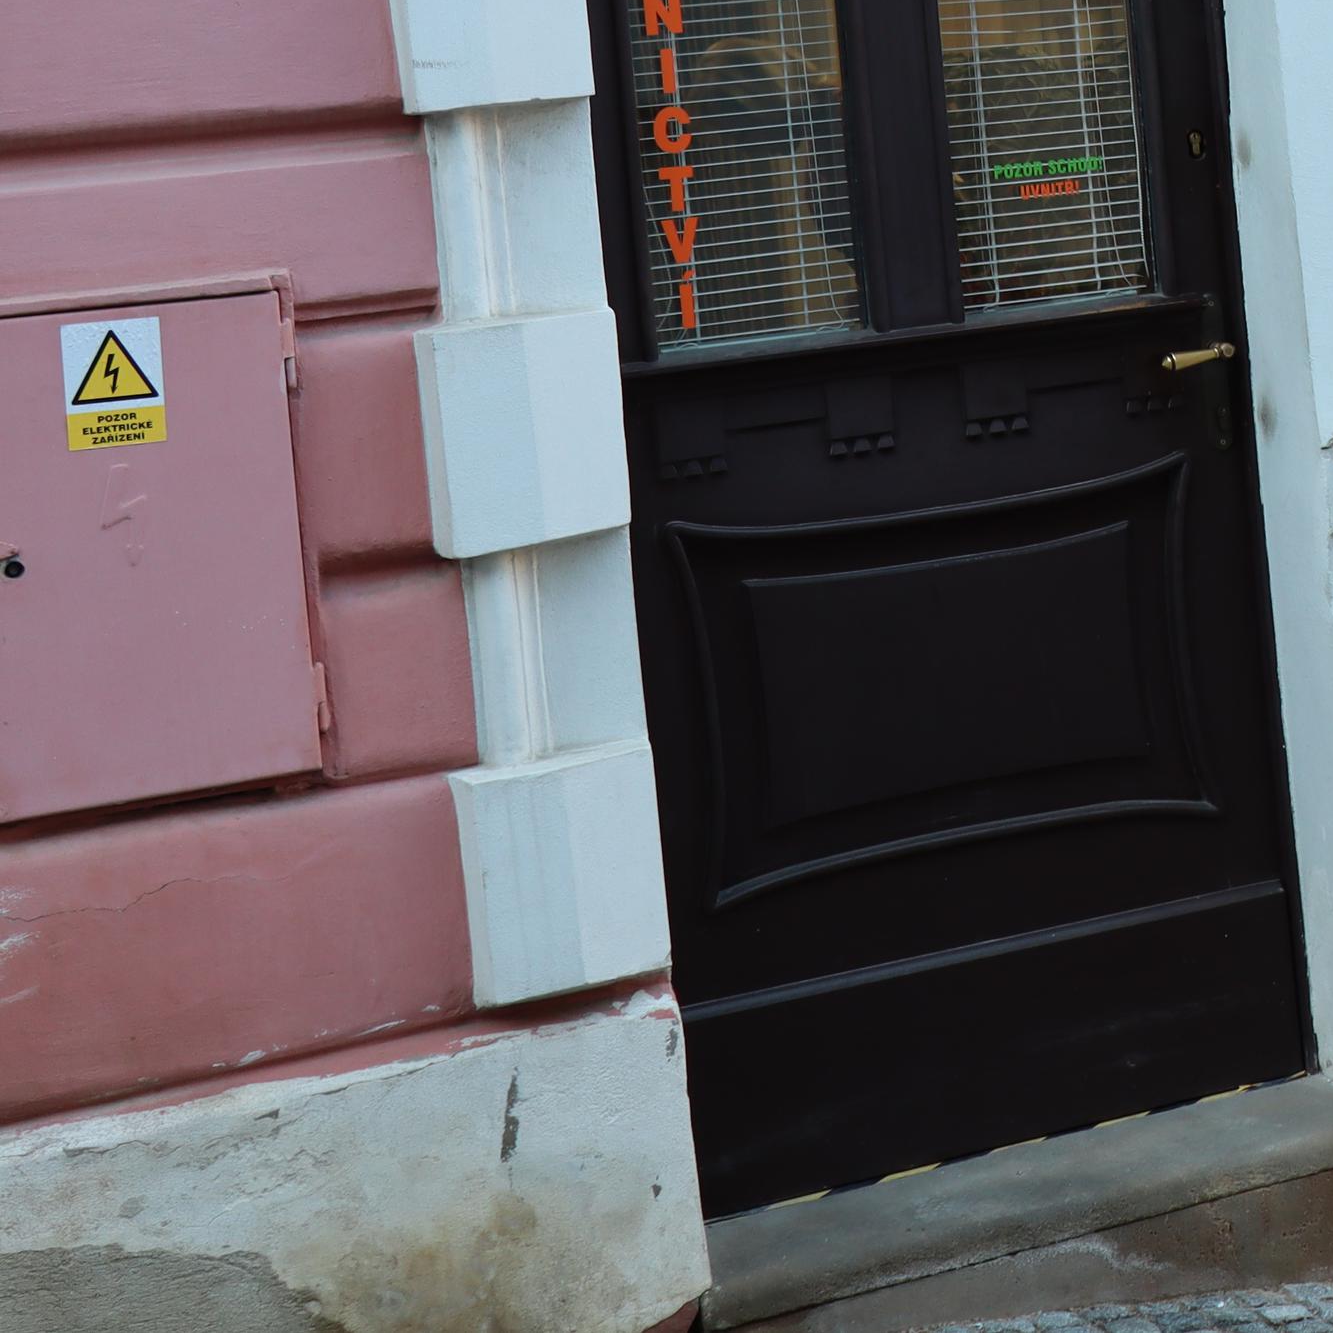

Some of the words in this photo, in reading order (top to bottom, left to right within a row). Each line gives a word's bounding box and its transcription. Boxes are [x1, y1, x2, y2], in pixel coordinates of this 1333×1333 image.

[993, 160, 1043, 179] POZOR
[97, 412, 137, 423] POZOR
[82, 419, 153, 435] ELEKTRICKÉ
[92, 432, 145, 444] ZAŘÍZENÍ
